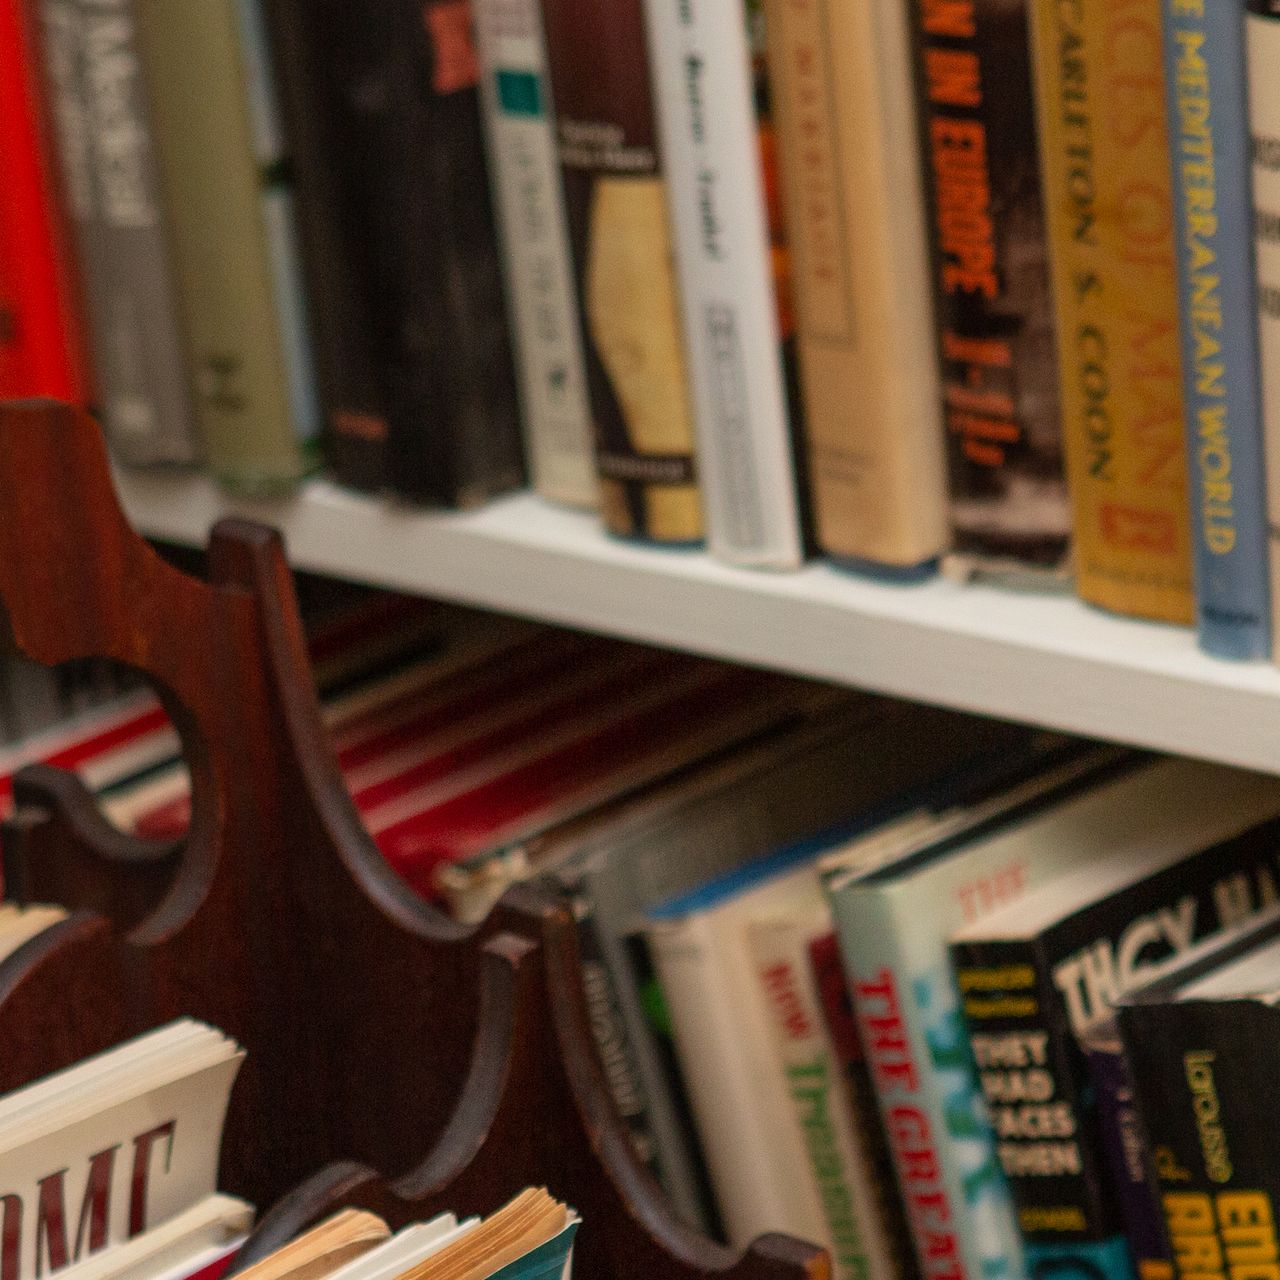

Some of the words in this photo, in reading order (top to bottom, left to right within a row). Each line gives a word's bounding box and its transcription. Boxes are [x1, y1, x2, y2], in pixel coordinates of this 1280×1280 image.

[924, 50, 982, 107] IN
[931, 118, 999, 298] EUROPE
[1174, 31, 1226, 398] MEDITERRANEAN
[1074, 322, 1114, 482] COON
[1196, 404, 1236, 554] WORLD
[854, 967, 920, 1092] THE
[971, 1032, 1049, 1068] THEY
[982, 1071, 1054, 1102] HAD
[1000, 1142, 1083, 1178] THEN
[1183, 1049, 1233, 1185] Larousse
